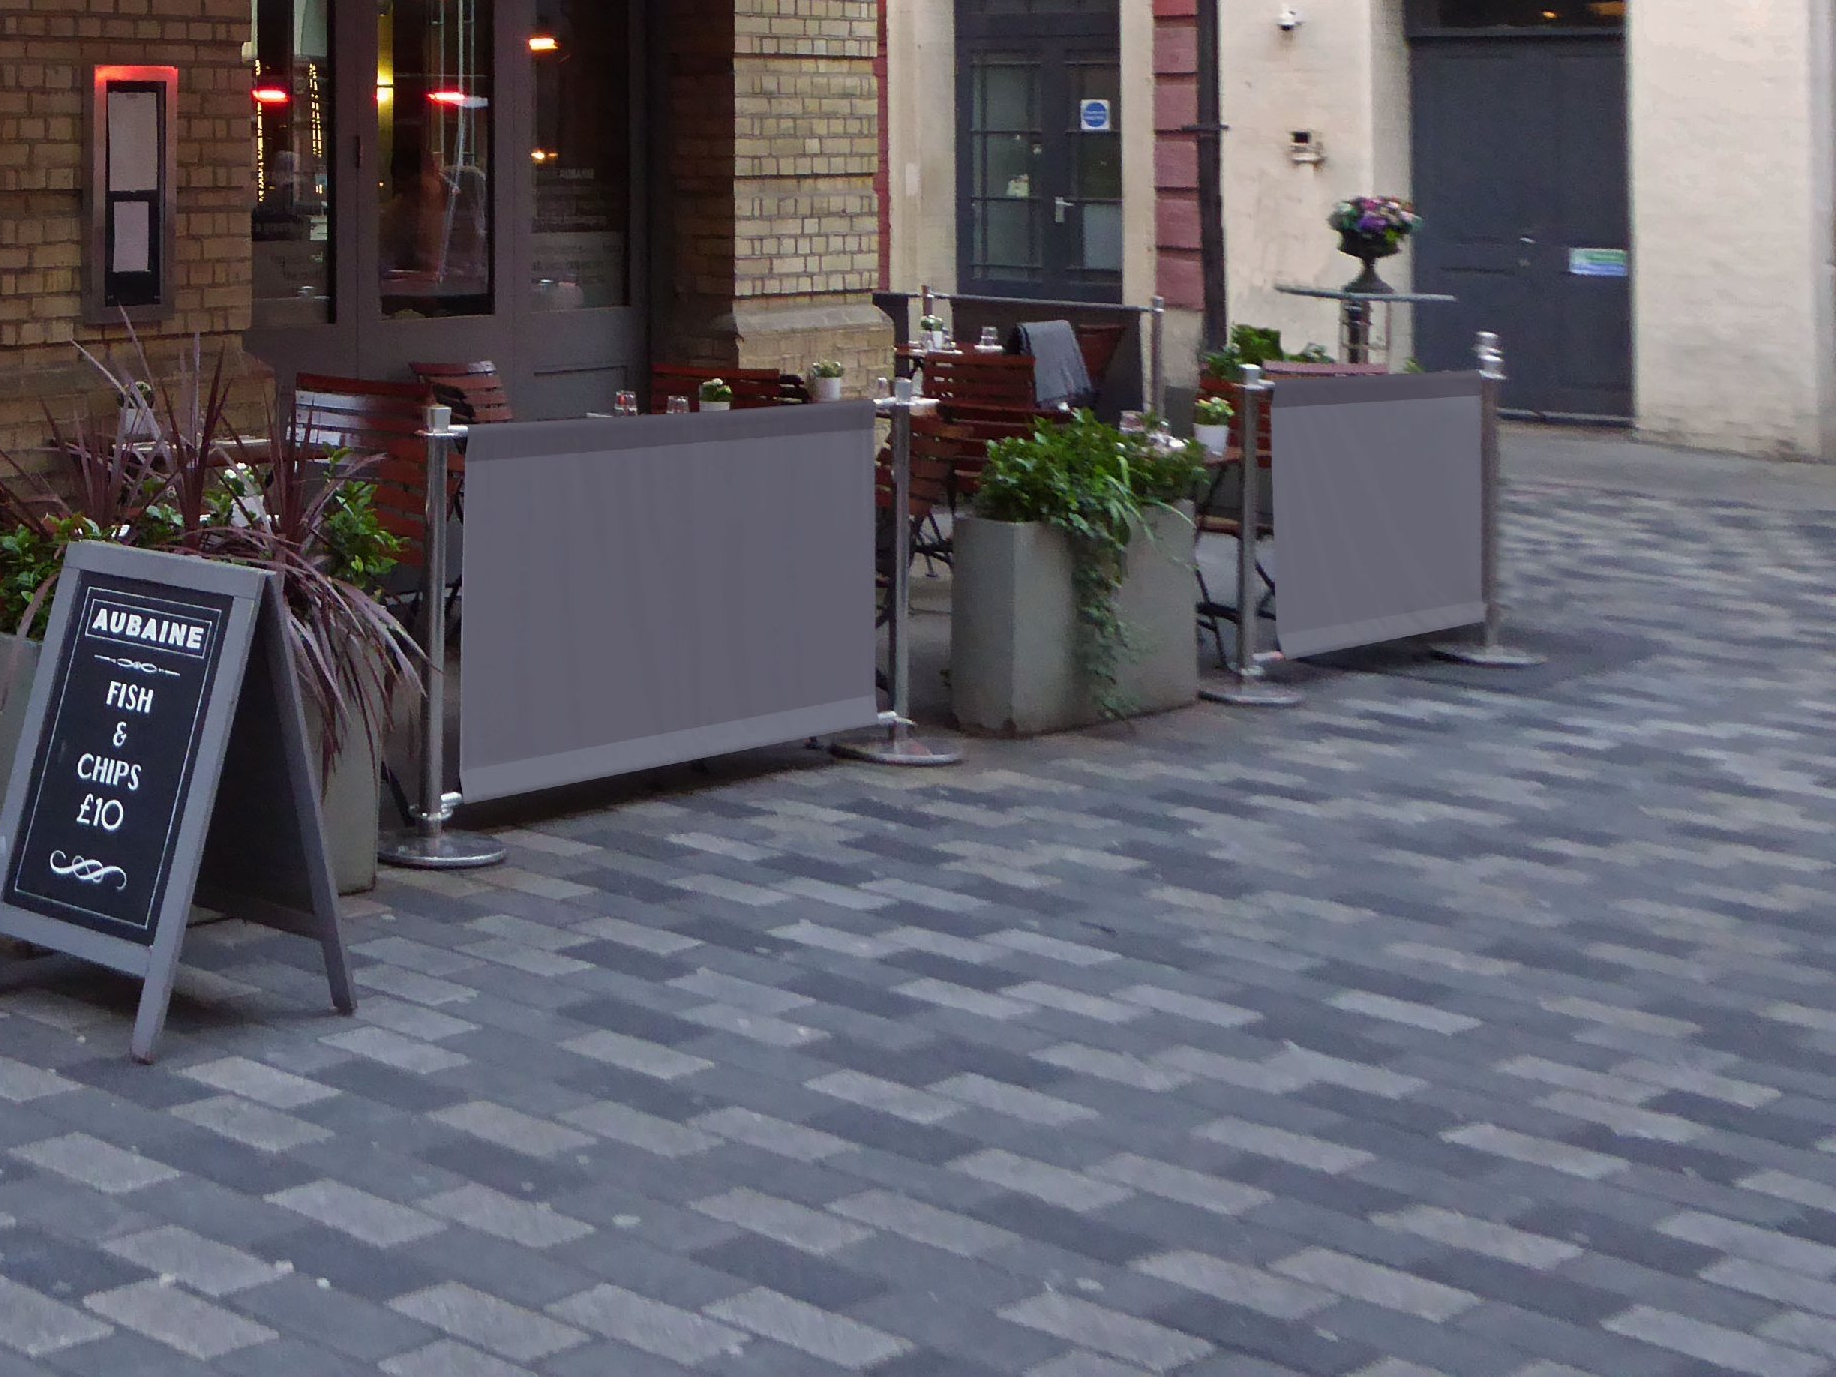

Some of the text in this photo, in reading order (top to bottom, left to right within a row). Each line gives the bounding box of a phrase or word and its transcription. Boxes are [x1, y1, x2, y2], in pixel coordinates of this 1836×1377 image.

[91, 608, 205, 650] AUBAINE
[105, 680, 154, 714] FISH
[113, 721, 127, 747] &
[77, 752, 142, 791] CHIPS
[76, 793, 124, 832] £10
